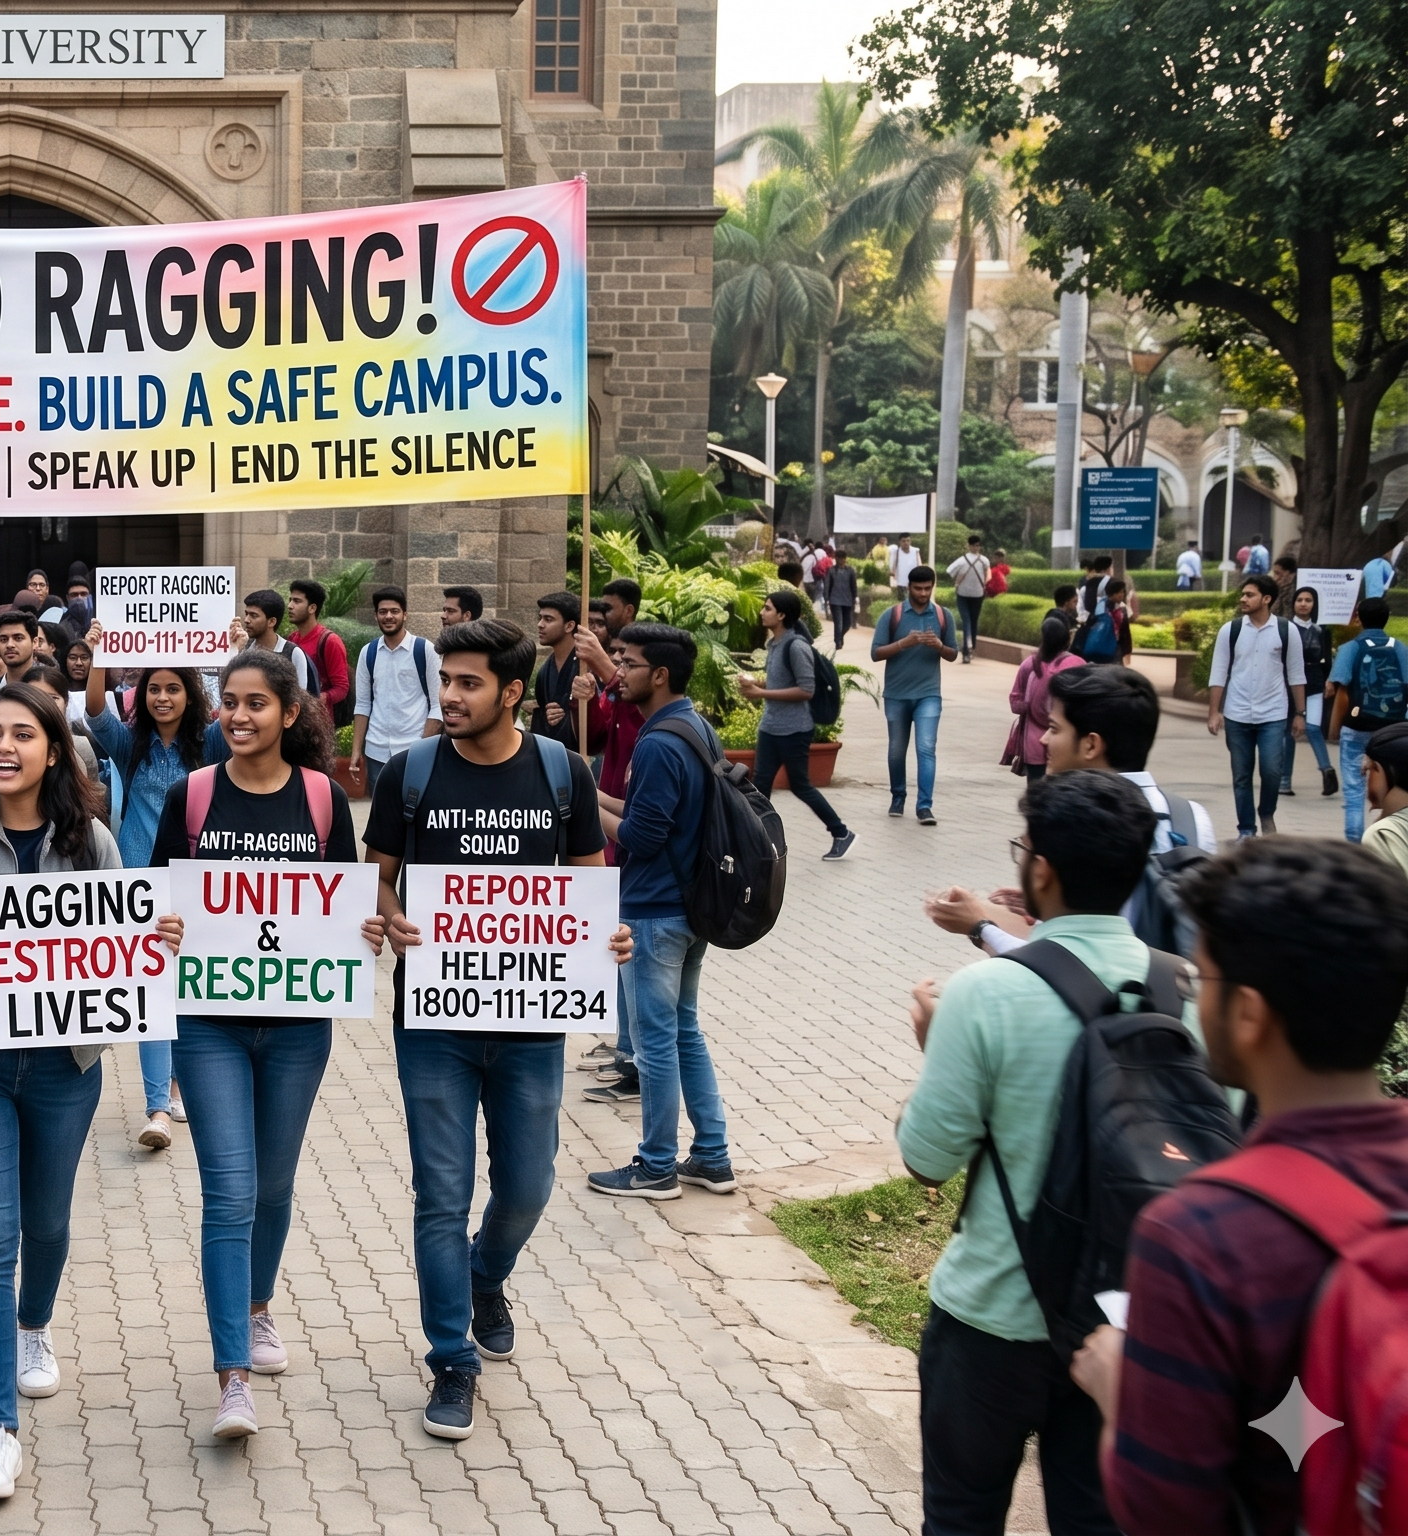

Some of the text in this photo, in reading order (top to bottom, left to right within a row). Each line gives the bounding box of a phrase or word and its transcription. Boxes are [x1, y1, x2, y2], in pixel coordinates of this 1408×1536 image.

[36, 223, 438, 353] RAGGING!
[40, 375, 161, 431] BUILD
[182, 373, 212, 427] A
[228, 365, 338, 425] SAFE
[355, 348, 561, 417] CAMPUS.
[28, 451, 138, 490] SPEAK
[152, 449, 195, 487] UP
[232, 444, 299, 483] END
[312, 438, 378, 479] THE
[391, 428, 536, 475] SILENCE
[100, 575, 229, 595] REPORT RAGGING:
[126, 603, 198, 623] HELPINE
[103, 631, 229, 653] 1800-111-1234
[427, 809, 551, 829] ANTI-RAGGING
[200, 831, 316, 852] ANTI-RAGGING
[460, 835, 519, 855] SQUAD
[204, 872, 344, 915] UNITY
[445, 875, 572, 905] REPORT
[258, 921, 281, 951] &
[435, 913, 588, 945] RAGGING:
[179, 956, 362, 1002] RESPECT
[442, 952, 566, 981] HELPINE
[9, 986, 147, 1037] LIVES!
[412, 988, 606, 1020] 1800-111-1234
